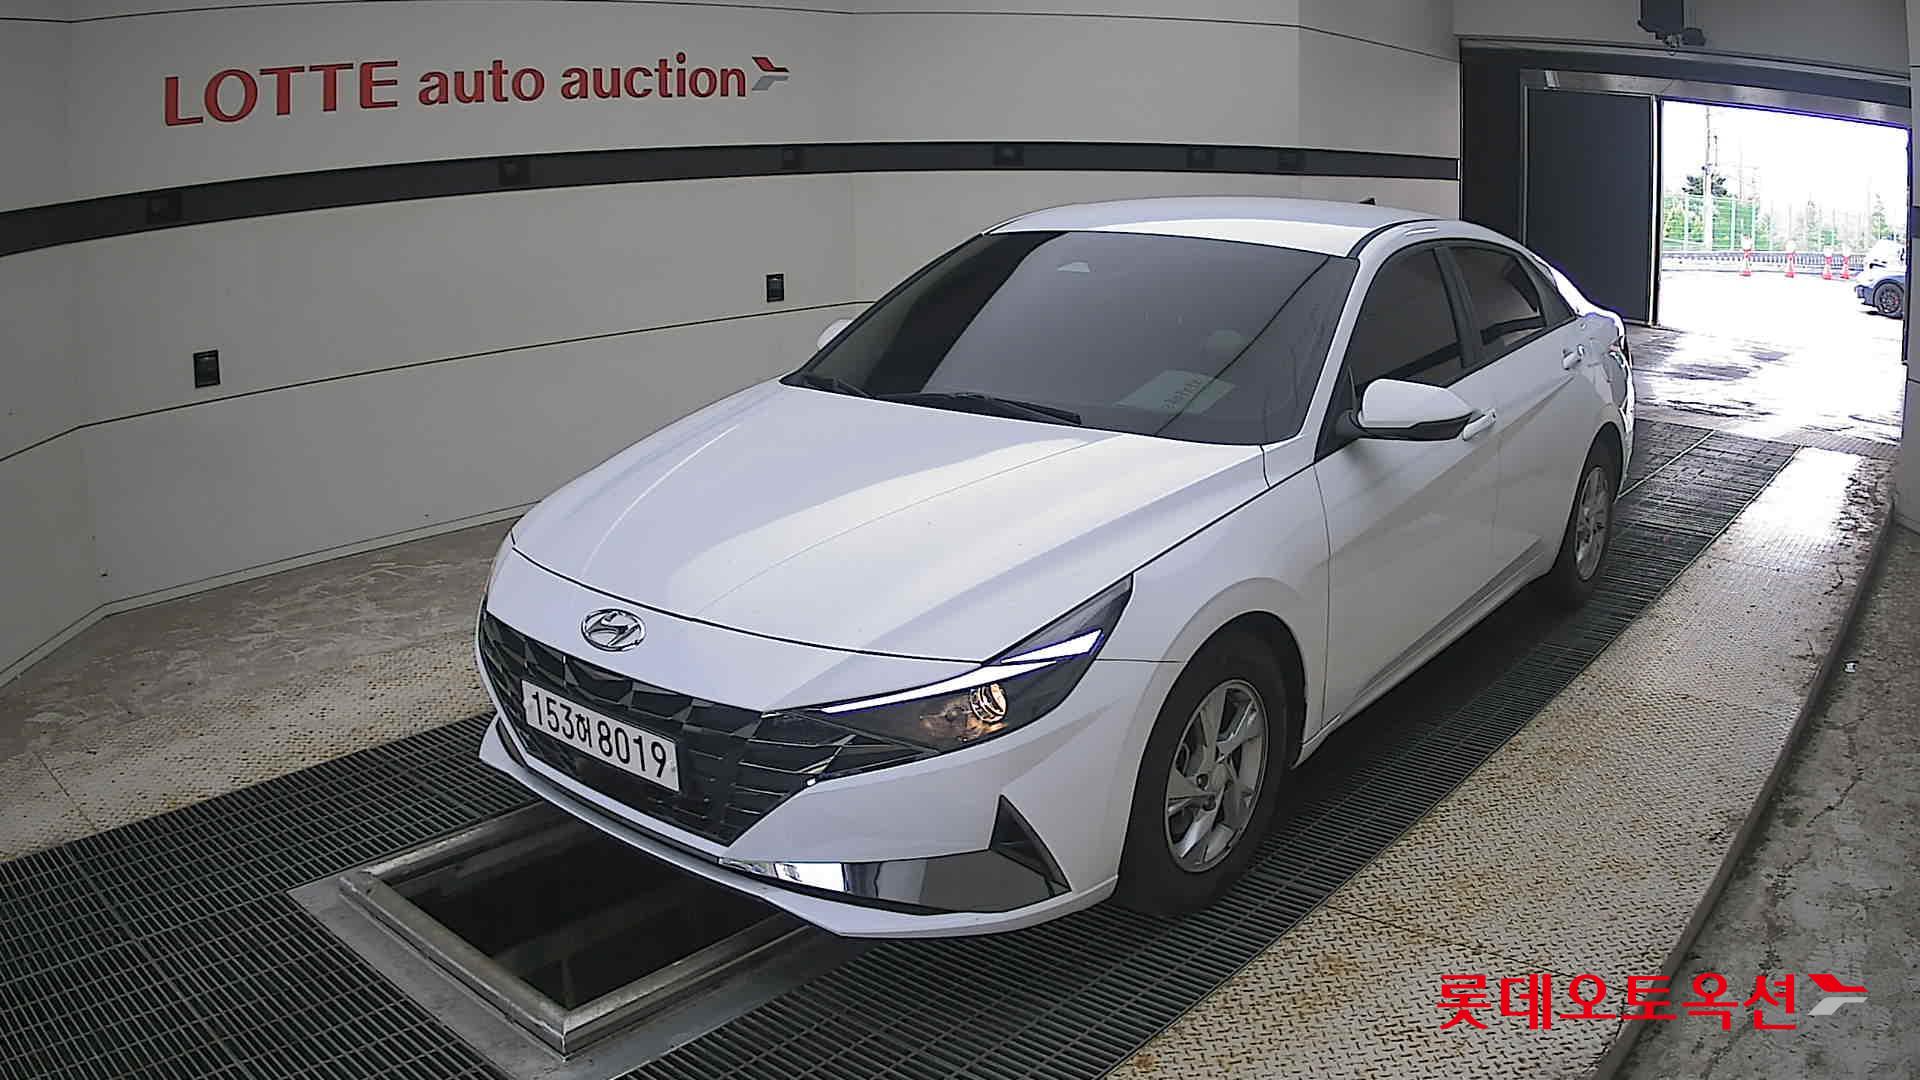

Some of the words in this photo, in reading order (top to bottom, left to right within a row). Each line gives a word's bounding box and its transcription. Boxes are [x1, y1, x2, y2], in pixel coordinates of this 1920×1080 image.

[164, 60, 400, 127] LOTTE
[417, 59, 546, 106] auto
[560, 51, 748, 99] auction
